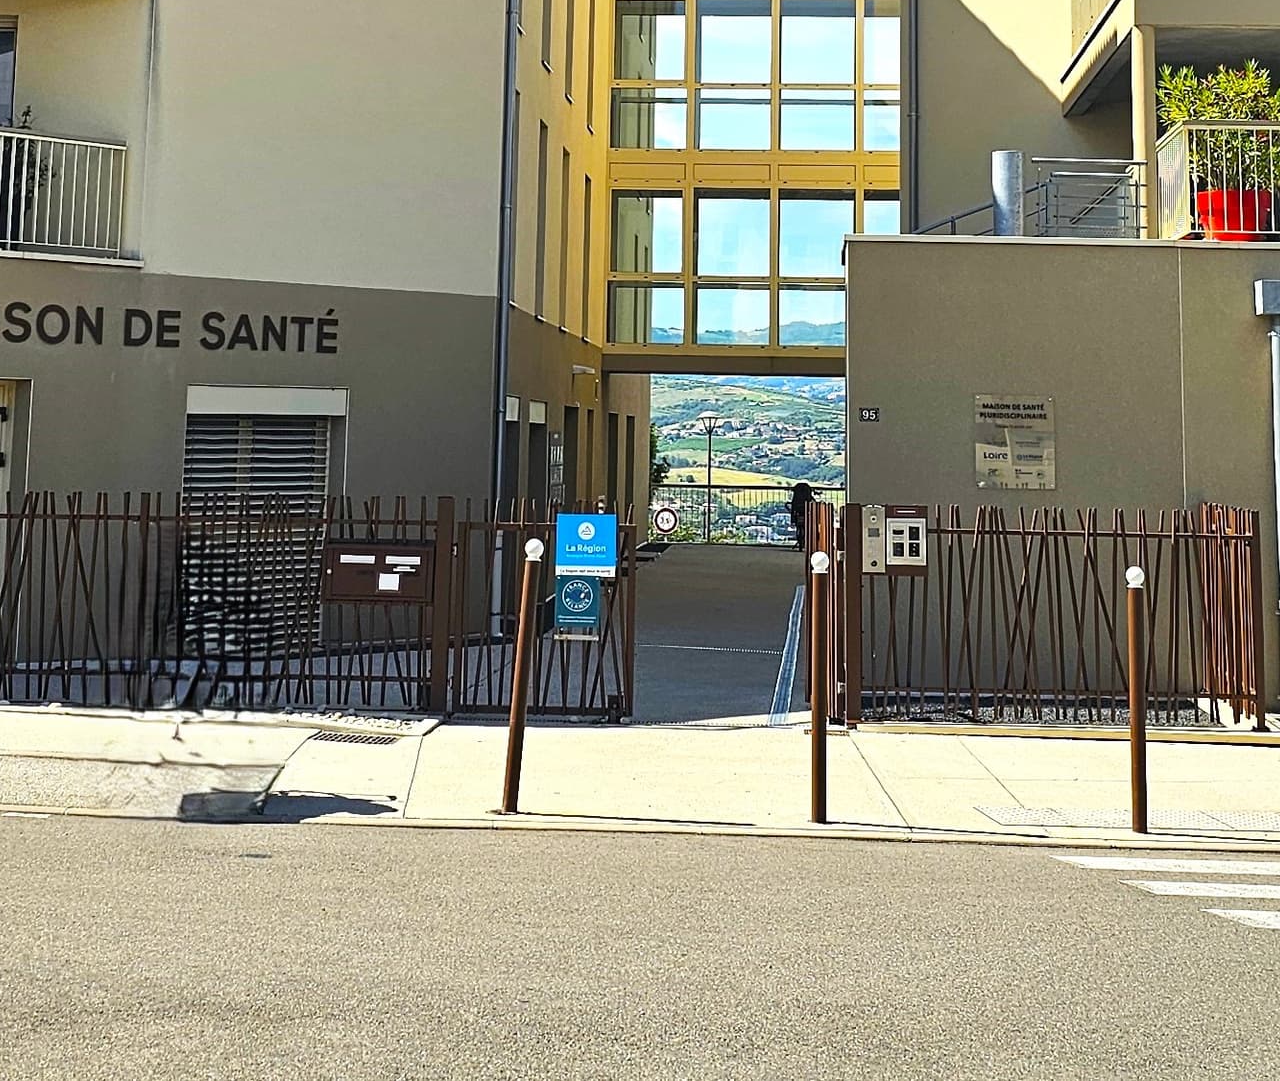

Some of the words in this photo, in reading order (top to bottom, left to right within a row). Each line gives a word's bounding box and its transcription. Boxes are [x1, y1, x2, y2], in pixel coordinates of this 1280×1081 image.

[123, 308, 182, 348] DE
[199, 307, 340, 354] SANTÉ
[1011, 403, 1022, 411] DE
[1022, 403, 1045, 411] SANTÉ
[862, 409, 876, 420] 95
[979, 412, 1048, 420] PLURIDISCIPLINAIRE
[983, 451, 1009, 460] Loire
[565, 543, 577, 552] La
[577, 543, 607, 554] Région
